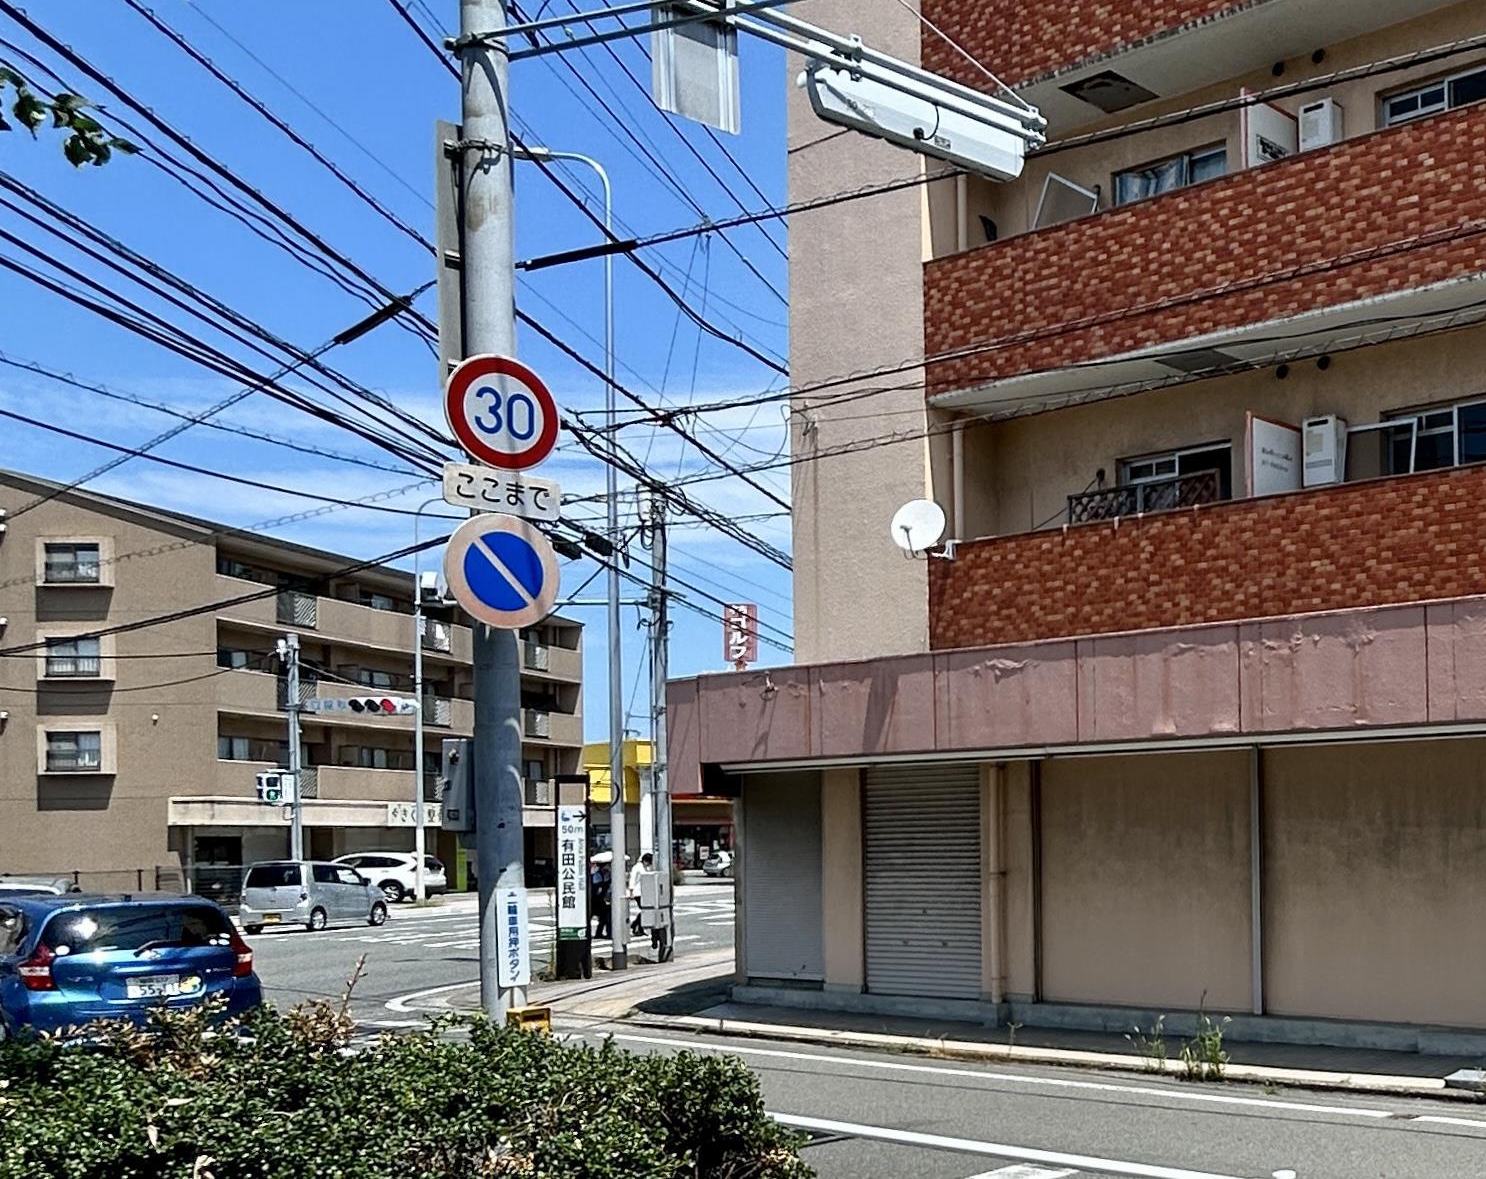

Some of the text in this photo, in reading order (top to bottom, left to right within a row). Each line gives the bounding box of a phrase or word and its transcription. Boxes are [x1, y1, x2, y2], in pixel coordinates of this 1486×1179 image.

[474, 386, 535, 440] 30
[456, 472, 550, 511] ここまで
[562, 838, 576, 909] 有田公民館
